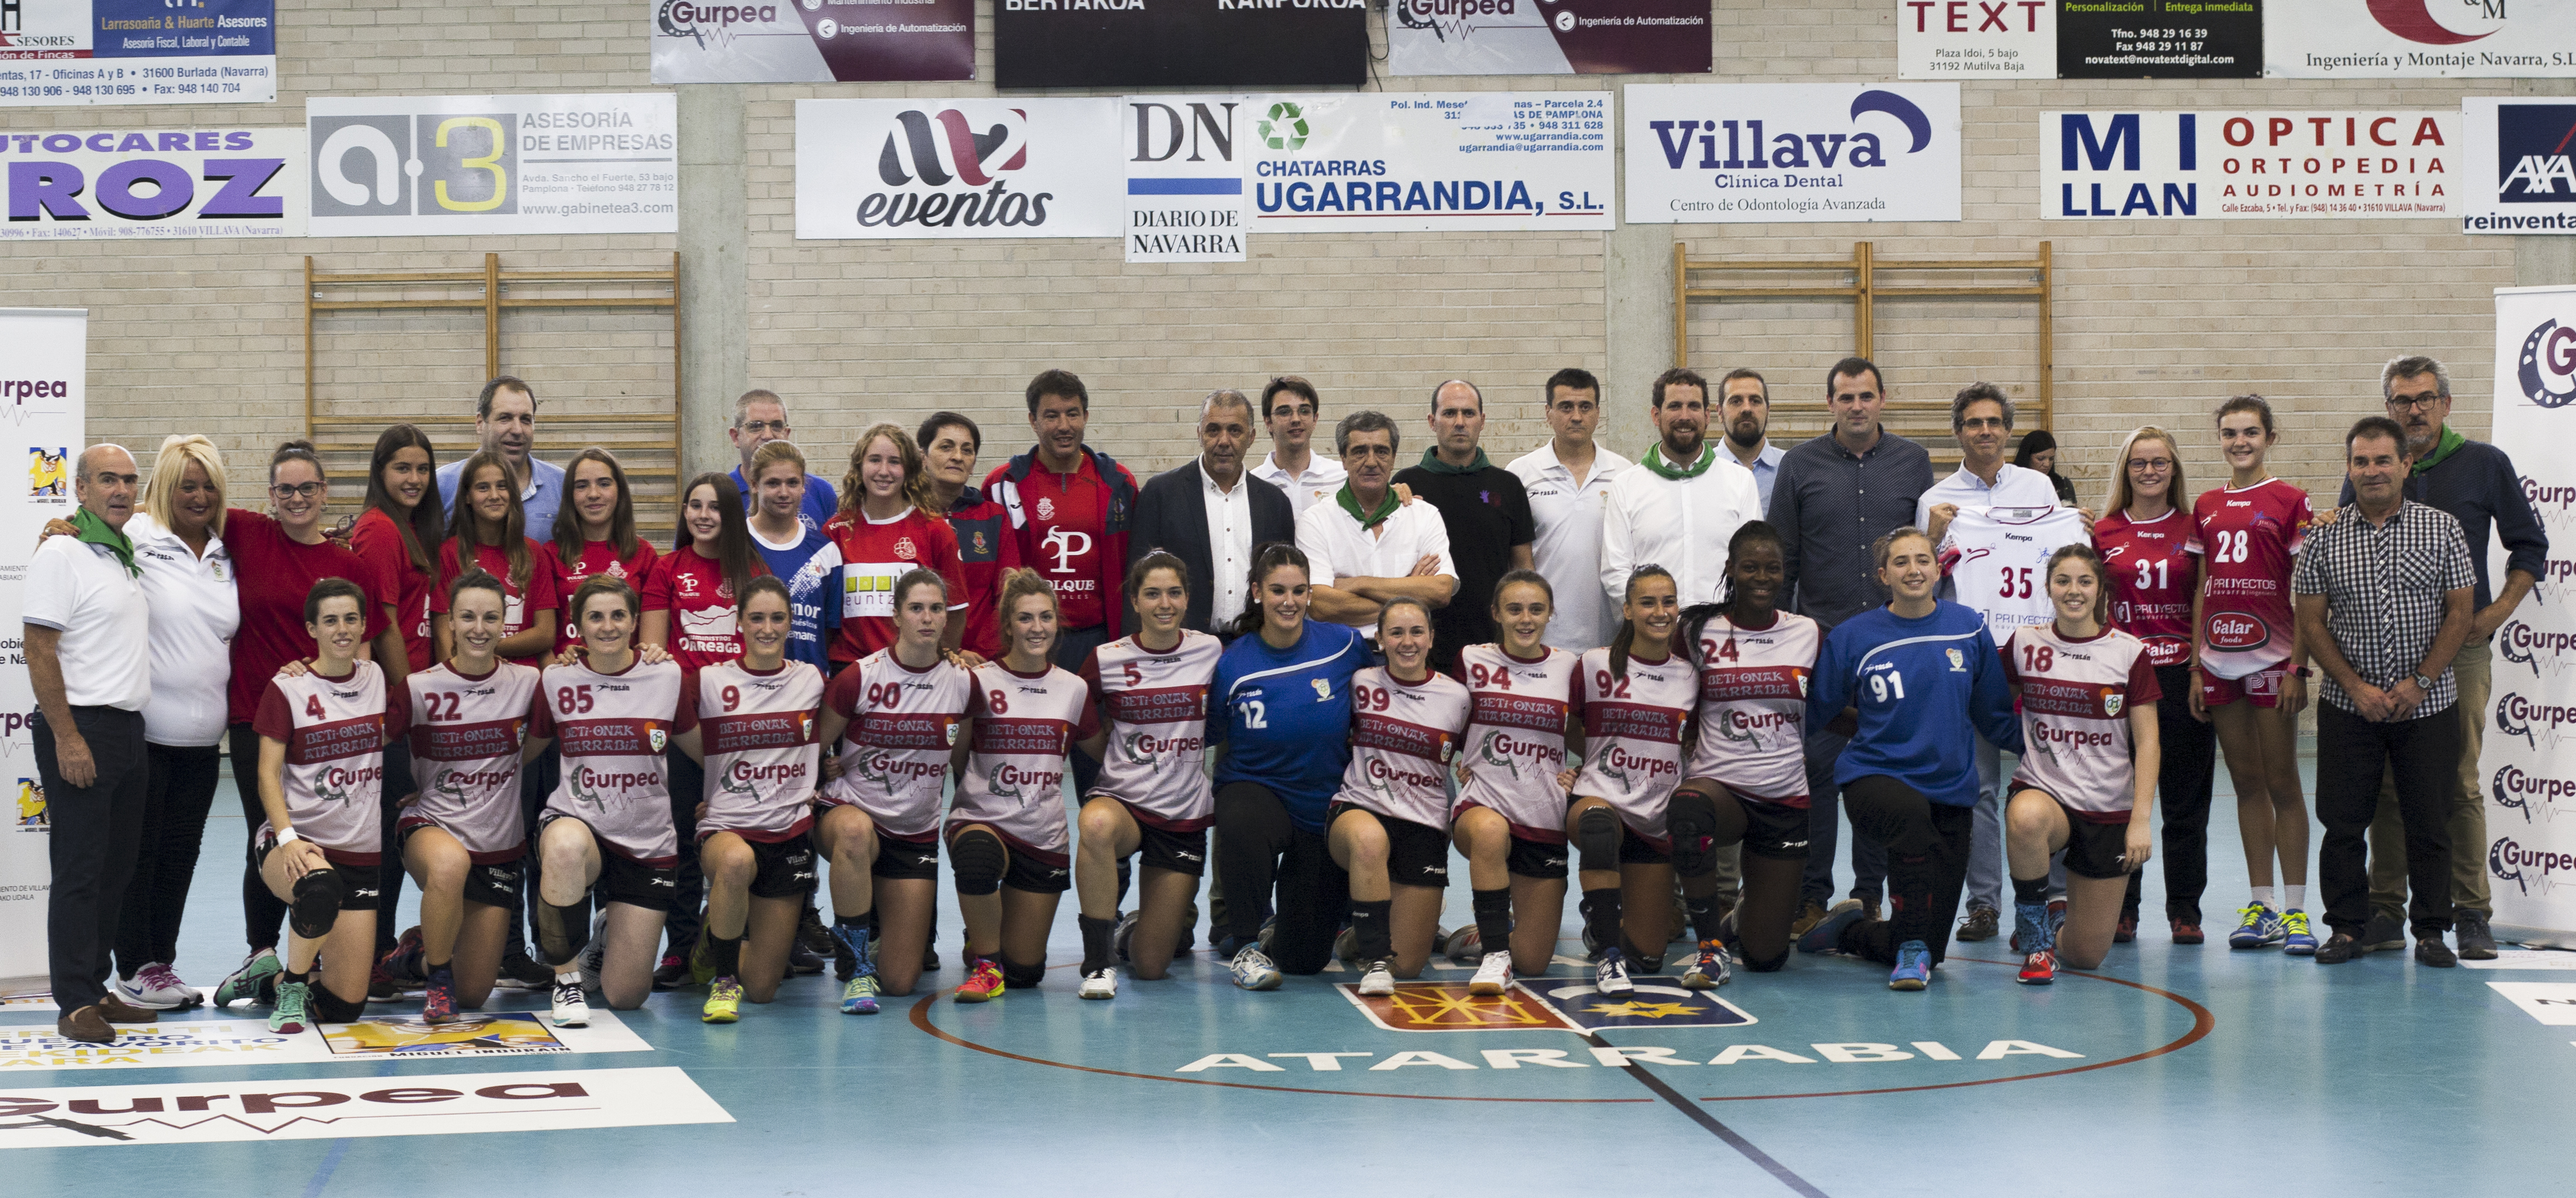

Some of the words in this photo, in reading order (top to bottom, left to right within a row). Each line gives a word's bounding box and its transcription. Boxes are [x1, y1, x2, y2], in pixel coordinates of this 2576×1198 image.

[672, 1, 776, 27] Gurpea
[1908, 1, 2047, 32] TEXT
[2066, 2, 2144, 13] Personalización
[2165, 2, 2202, 13] Entrega
[2205, 2, 2253, 12] inmediata
[102, 16, 161, 30] Larrasoaña
[165, 16, 174, 29] &
[178, 16, 215, 28] Huarte
[217, 15, 267, 27] Asesores
[1579, 16, 1620, 29] Ingeniería
[1623, 17, 1635, 25] de
[1636, 16, 1703, 26] Automatización
[2111, 29, 2137, 39] Tfno.
[2140, 29, 2160, 38] 948
[2163, 29, 2176, 38] 29
[2179, 29, 2192, 38] 16
[2195, 29, 2208, 38] 39
[123, 36, 155, 49] Asesoría
[157, 36, 180, 49] Fiscal,
[182, 36, 209, 47] Laboral
[211, 39, 216, 49] y
[218, 35, 250, 47] Contable
[1935, 49, 1961, 58] Plaza
[1964, 49, 1986, 59] Idoi,
[1988, 49, 1995, 58] 5
[1997, 48, 2019, 59] bajo
[2116, 41, 2134, 51] Fax
[2136, 41, 2156, 51] 948
[2159, 41, 2172, 51] 29
[2175, 41, 2188, 51] 11
[2190, 41, 2204, 50] 87
[37, 51, 75, 59] Fincas
[1929, 61, 1960, 71] 31192
[1963, 61, 2001, 71] Mutilva
[2003, 60, 2025, 73] Baja
[2085, 54, 2234, 66] novatext@novatextdigital.com
[2306, 53, 2388, 70] Ingeniería
[2393, 56, 2403, 69] y
[2408, 53, 2475, 69] Montaje
[2480, 52, 2548, 68] Navarra,
[30, 70, 41, 79] 17
[53, 69, 94, 79] Oficinas
[98, 69, 105, 79] A
[107, 71, 113, 81] y
[117, 69, 124, 78] B
[143, 68, 174, 78] 31600
[177, 67, 217, 77] Burlada
[221, 66, 268, 79] (Navarra)
[0, 87, 18, 97] 948
[22, 86, 40, 96] 130
[44, 86, 62, 96] 906
[73, 86, 92, 96] 948
[95, 86, 113, 95] 130
[116, 85, 135, 94] 695
[154, 84, 175, 94] Fax:
[178, 84, 197, 93] 948
[200, 83, 219, 93] 140
[222, 83, 240, 93] 704
[1545, 100, 1584, 108] Parcela
[522, 108, 633, 129] ASESORÍA
[523, 135, 550, 151] DE
[557, 134, 673, 150] EMPRESAS
[1130, 103, 1239, 162] DN
[1496, 132, 1603, 141] www.ugarrandia.com
[2223, 117, 2445, 146] OPTICA
[1459, 143, 1603, 153] ugarrandia@ugarrandia.com
[1650, 120, 1886, 169] Villava
[1257, 160, 1386, 177] CHATARRAS
[2223, 158, 2445, 174] ORTOPEDIA
[2499, 154, 2576, 193] AXA
[8, 158, 286, 221] ROZ
[1715, 174, 1779, 189] Clínica
[1784, 173, 1843, 188] Dental
[2223, 180, 2445, 197] AUDIOMETRÍA
[522, 202, 674, 216] www.gabinetea3.com
[856, 179, 1053, 227] eventos
[1257, 181, 1543, 216] UGARRANDIA,
[1559, 191, 1603, 210] S.L.
[1670, 198, 1714, 211] Centro
[1718, 198, 1734, 211] de
[1737, 197, 1819, 214] Odontología
[1822, 197, 1886, 210] Avanzada
[2062, 183, 2197, 216] LLAN
[2222, 203, 2238, 212] Calle
[2241, 203, 2265, 213] Ezcaba,
[2277, 203, 2288, 212] Tel.
[2296, 203, 2309, 212] Fax:
[2310, 203, 2328, 213] (948)
[2330, 203, 2337, 211] 14
[2339, 203, 2347, 211] 36
[2348, 203, 2357, 211] 40
[2364, 203, 2383, 211] 31610
[2385, 202, 2412, 211] VILLAVA
[2414, 202, 2445, 212] (Navarra)
[1133, 210, 1206, 228] DIARIO
[1210, 210, 1238, 227] DE
[1133, 234, 1240, 254] NAVARRA
[2005, 532, 2033, 542] Kempa
[2214, 530, 2248, 563] 28
[2000, 566, 2033, 599] 35
[2135, 559, 2167, 589] 31
[2213, 619, 2253, 634] Galar
[1701, 638, 1740, 664] 24
[2023, 644, 2054, 673] 18
[2151, 656, 2174, 665] foods
[1123, 664, 1142, 687] 5
[1471, 663, 1512, 690] 94
[1595, 670, 1632, 699] 92
[1871, 671, 1905, 703] 91
[306, 694, 327, 721] 4
[424, 692, 462, 721] 22
[558, 684, 594, 715] 85
[721, 685, 740, 712] 9
[868, 682, 901, 709] 90
[989, 689, 1008, 715] 8
[1355, 685, 1390, 712] 99
[1239, 700, 1267, 729] 12
[2035, 721, 2113, 750] Gurpea
[1494, 734, 1562, 765] Gurpea
[582, 768, 659, 793] Gurpea
[734, 760, 806, 785] Gurpea
[1175, 1039, 2086, 1072] ATARRABIA
